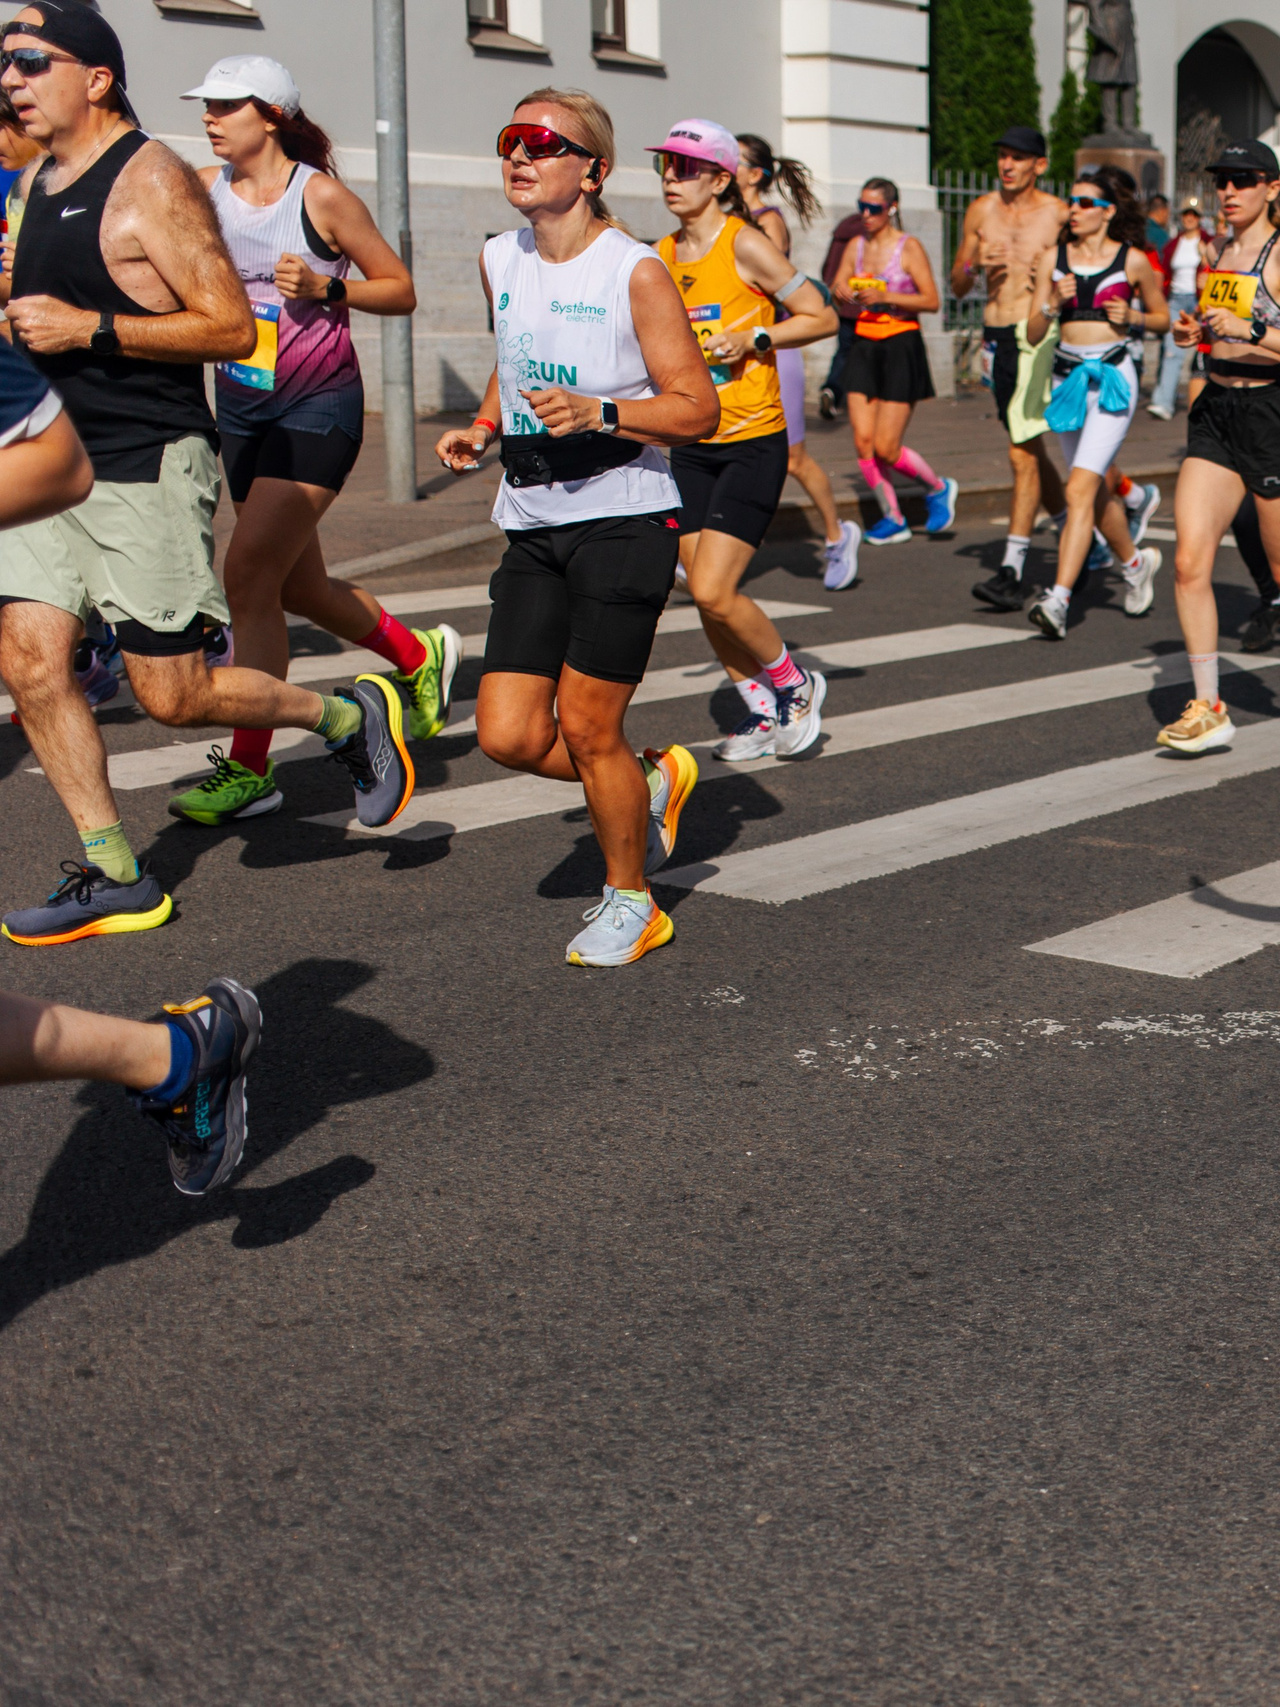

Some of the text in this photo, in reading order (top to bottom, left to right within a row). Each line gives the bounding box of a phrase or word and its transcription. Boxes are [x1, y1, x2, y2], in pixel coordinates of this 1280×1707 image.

[1210, 280, 1238, 303] 474
[550, 300, 606, 316] Système
[566, 313, 606, 325] electric
[527, 359, 577, 386] RUN
